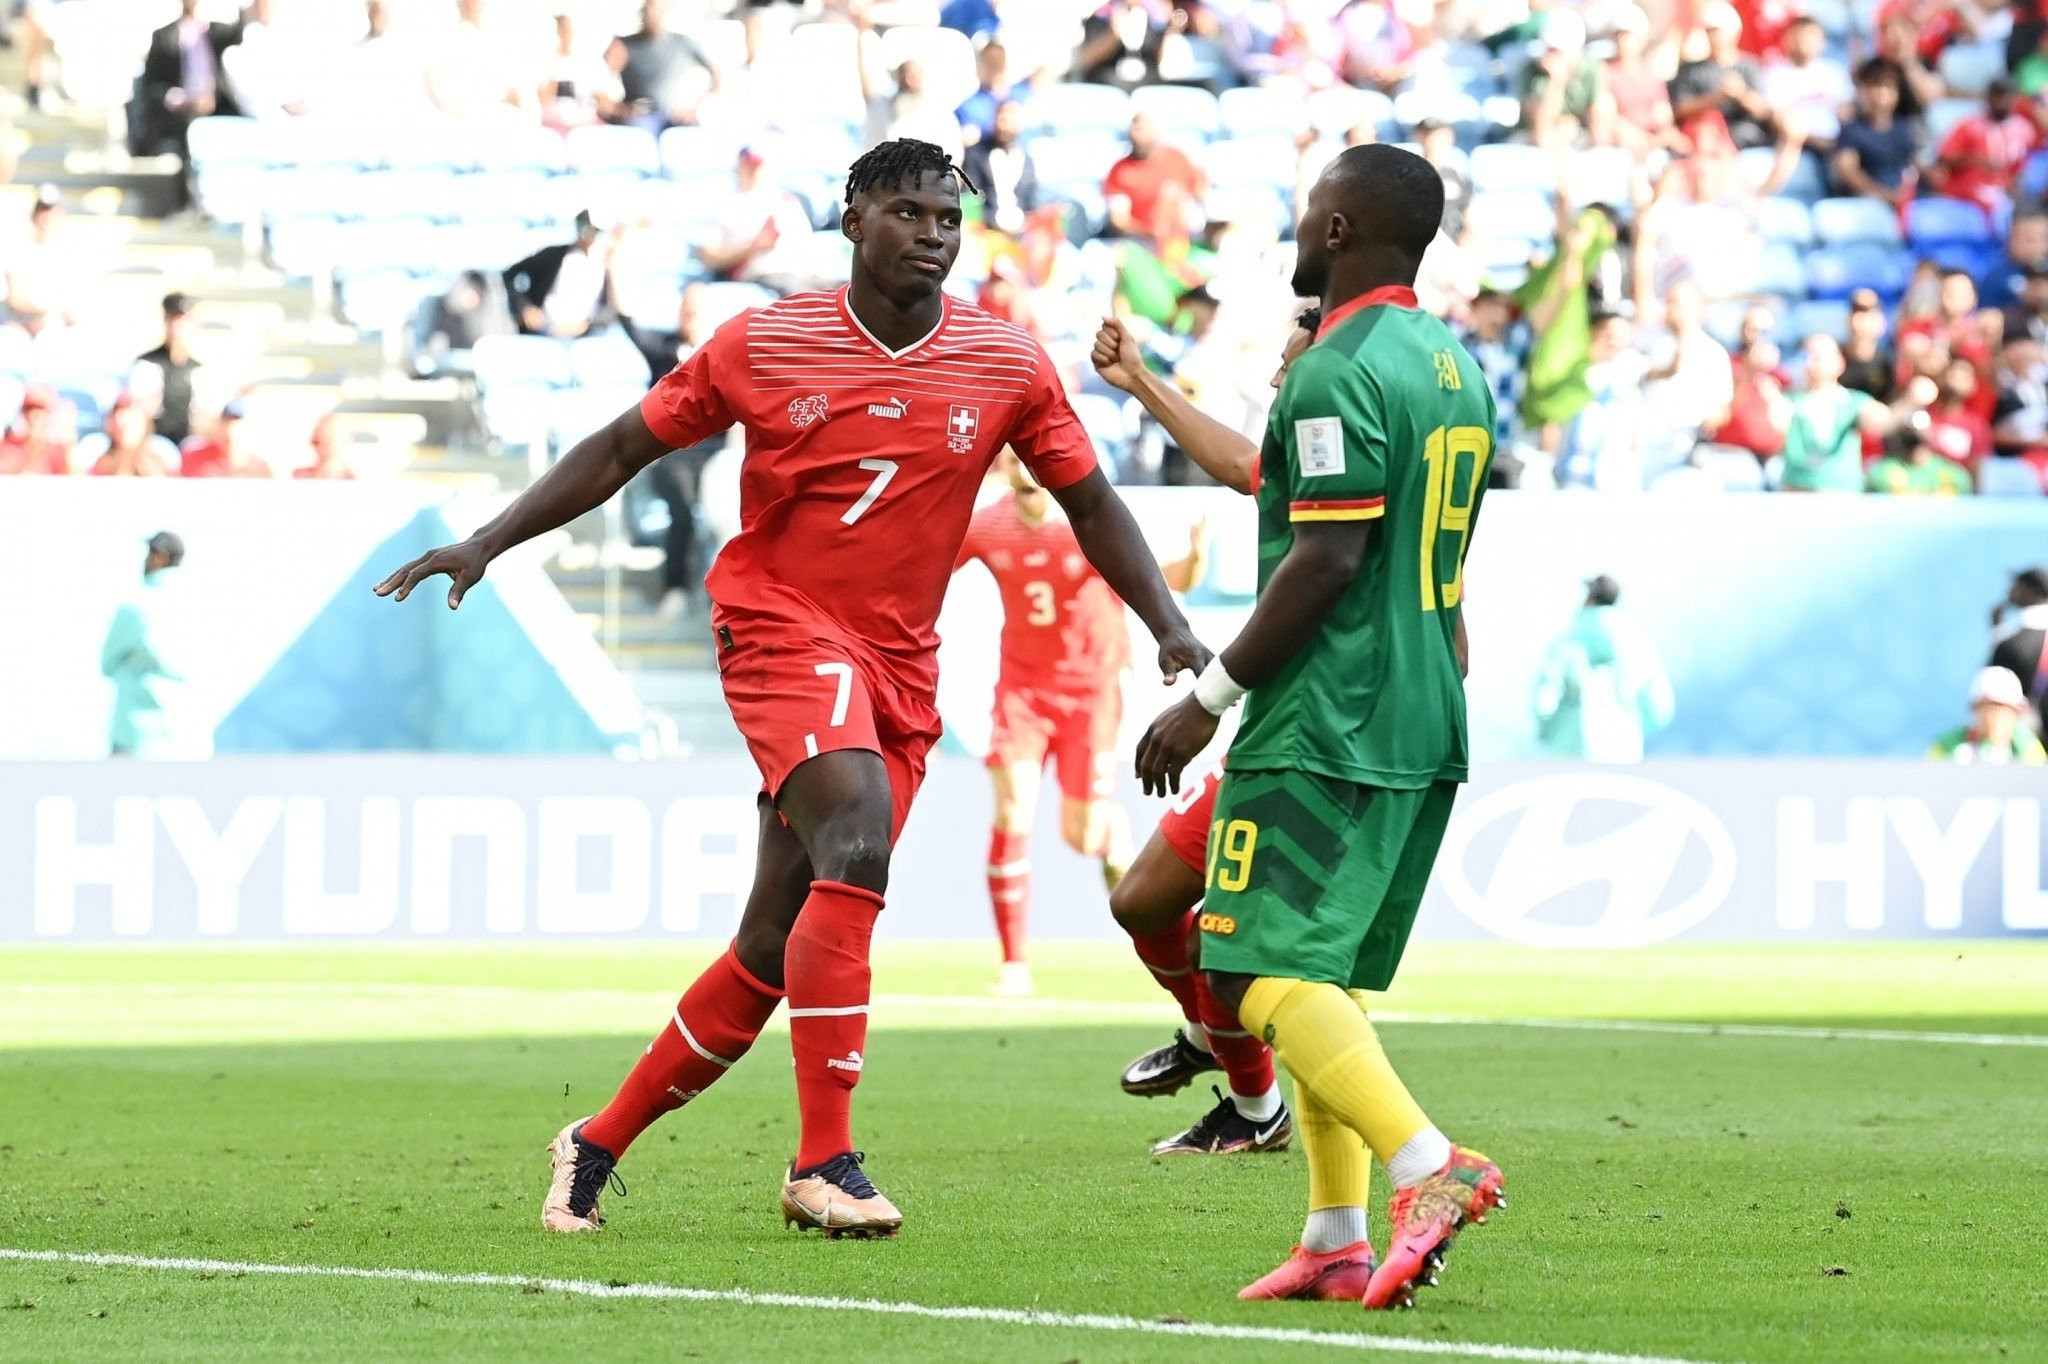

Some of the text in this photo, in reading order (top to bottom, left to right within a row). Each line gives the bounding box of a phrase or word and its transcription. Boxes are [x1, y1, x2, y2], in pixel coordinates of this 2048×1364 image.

[867, 404, 902, 420] PUMA
[839, 458, 900, 526] 7
[1420, 424, 1491, 612] 19
[1024, 581, 1056, 627] 3
[813, 661, 854, 728] 7
[1205, 818, 1259, 892] 19
[1200, 913, 1236, 935] one
